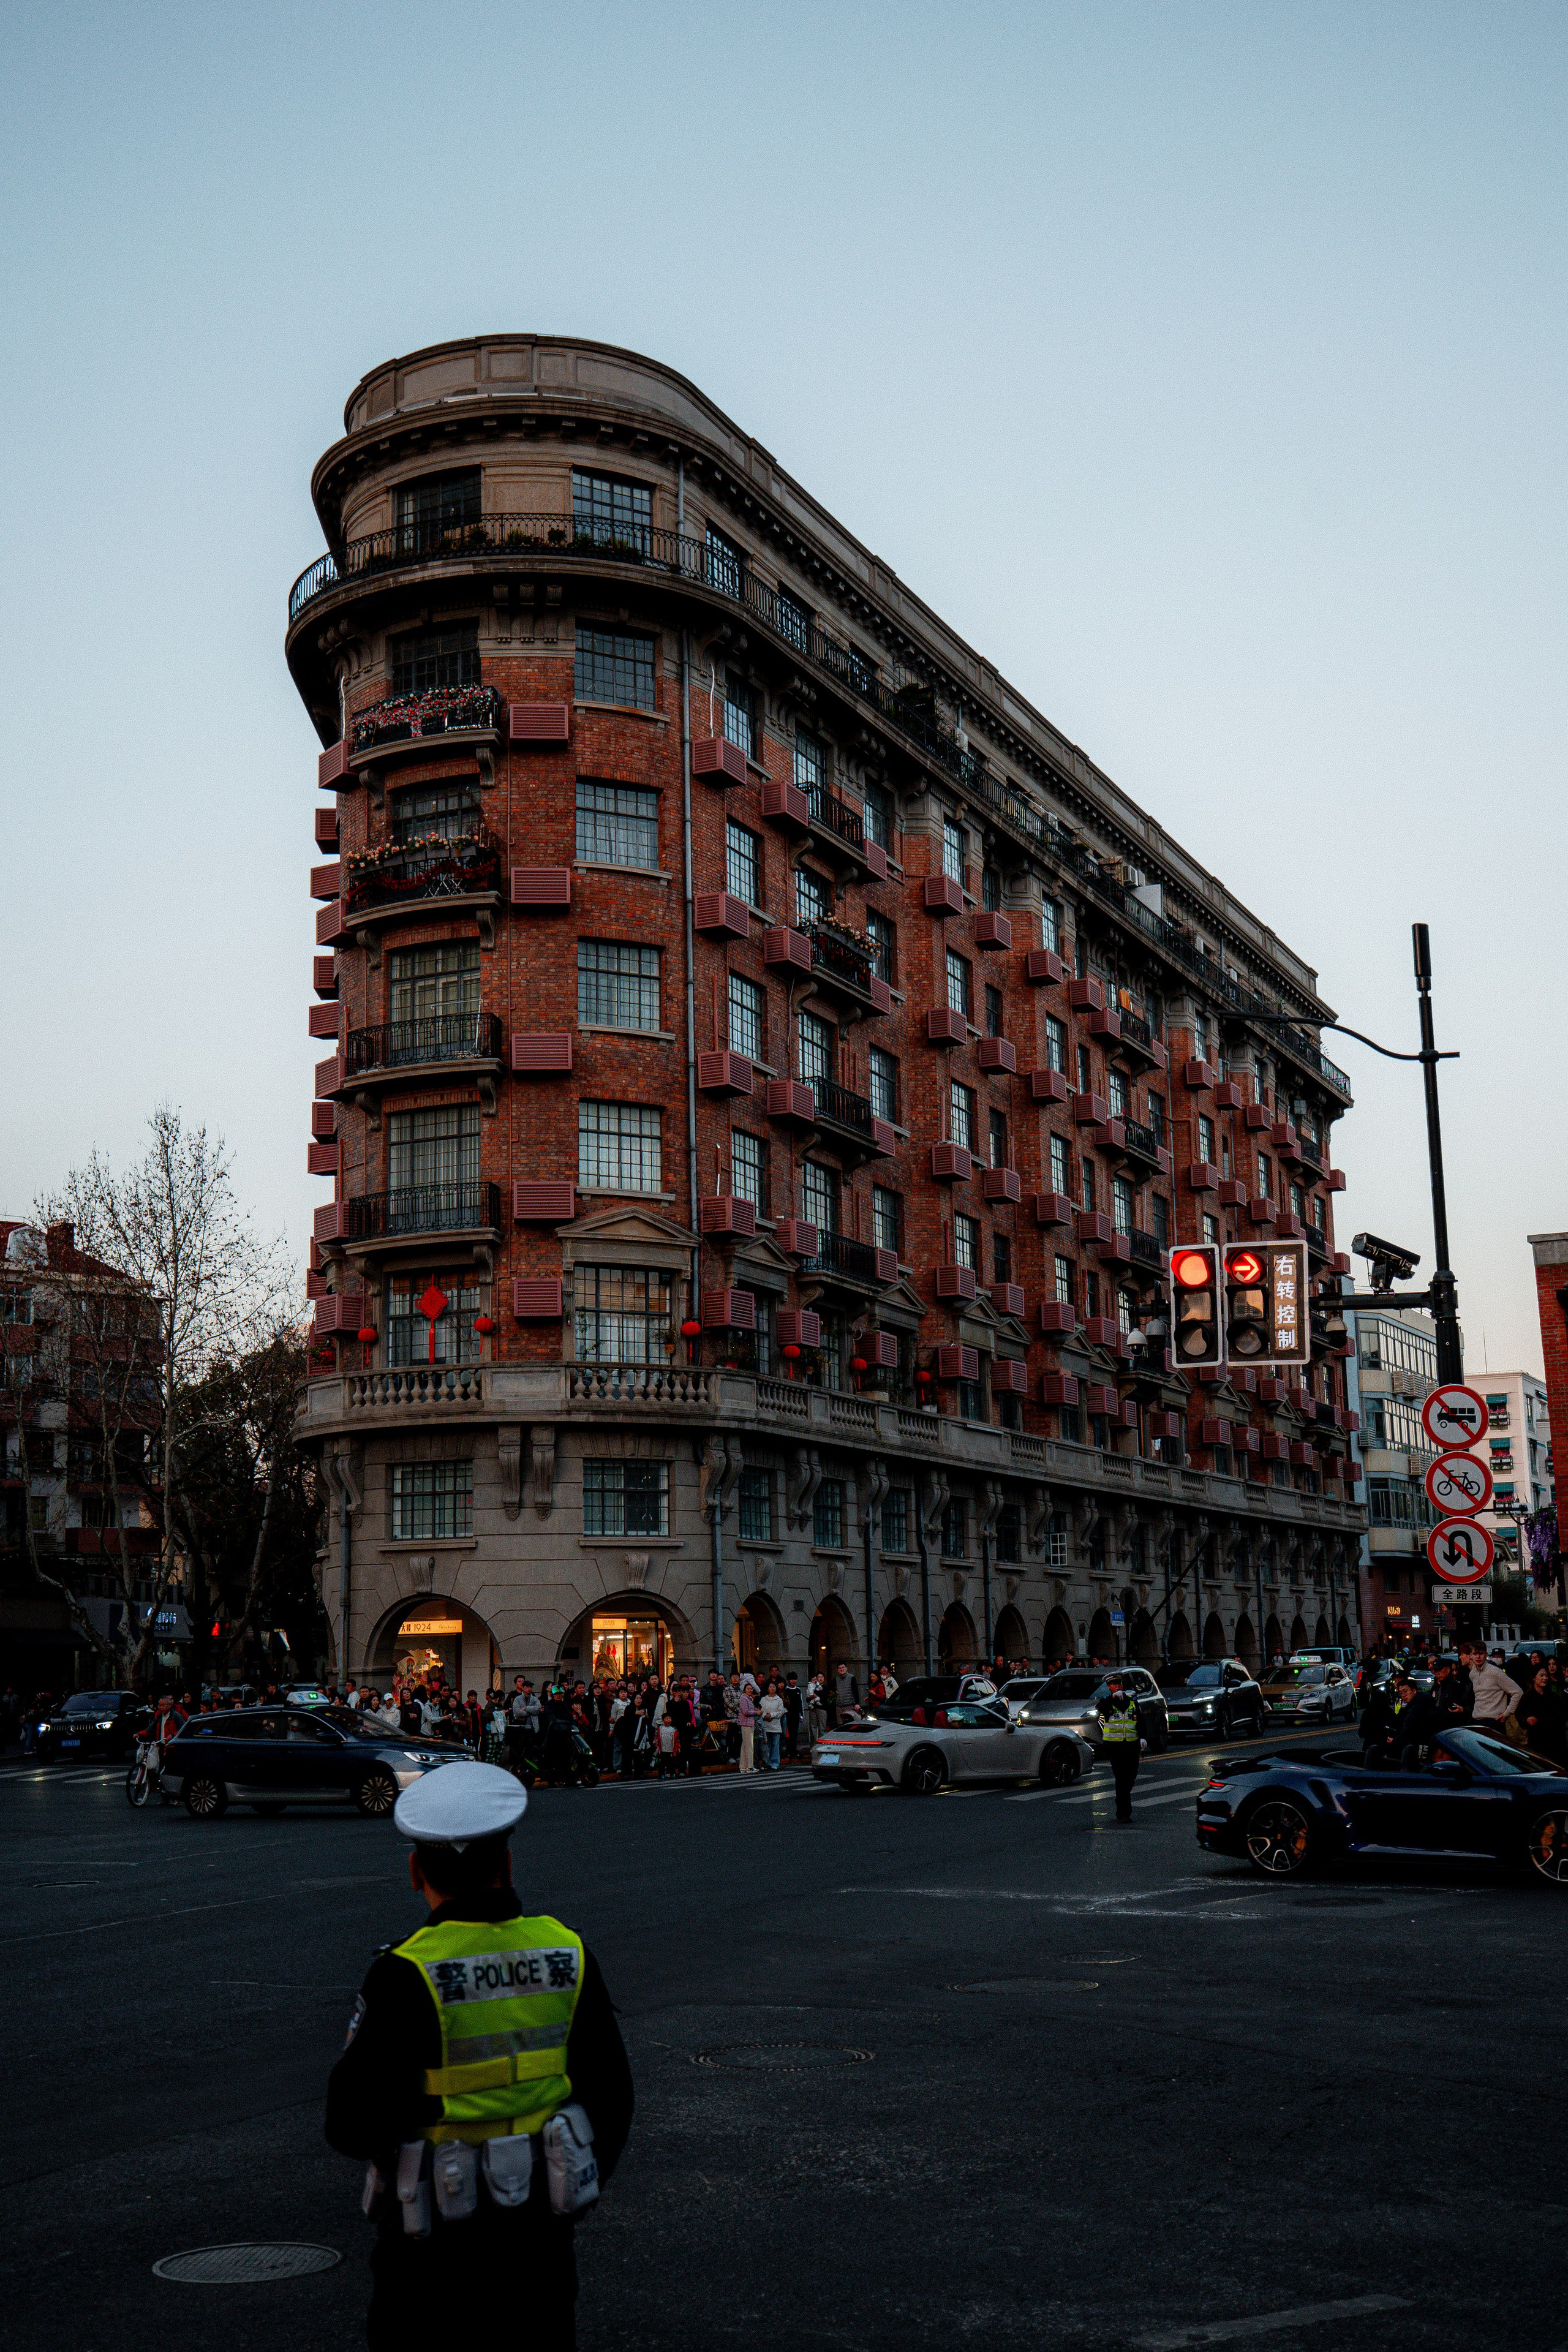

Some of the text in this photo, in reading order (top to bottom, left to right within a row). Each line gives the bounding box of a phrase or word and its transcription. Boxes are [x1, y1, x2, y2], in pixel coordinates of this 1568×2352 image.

[1276, 1256, 1295, 1349] 右转控制
[1442, 1588, 1482, 1600] 全路段
[414, 1623, 431, 1632] 1924
[435, 1951, 576, 2002] 警 POLICE 察
